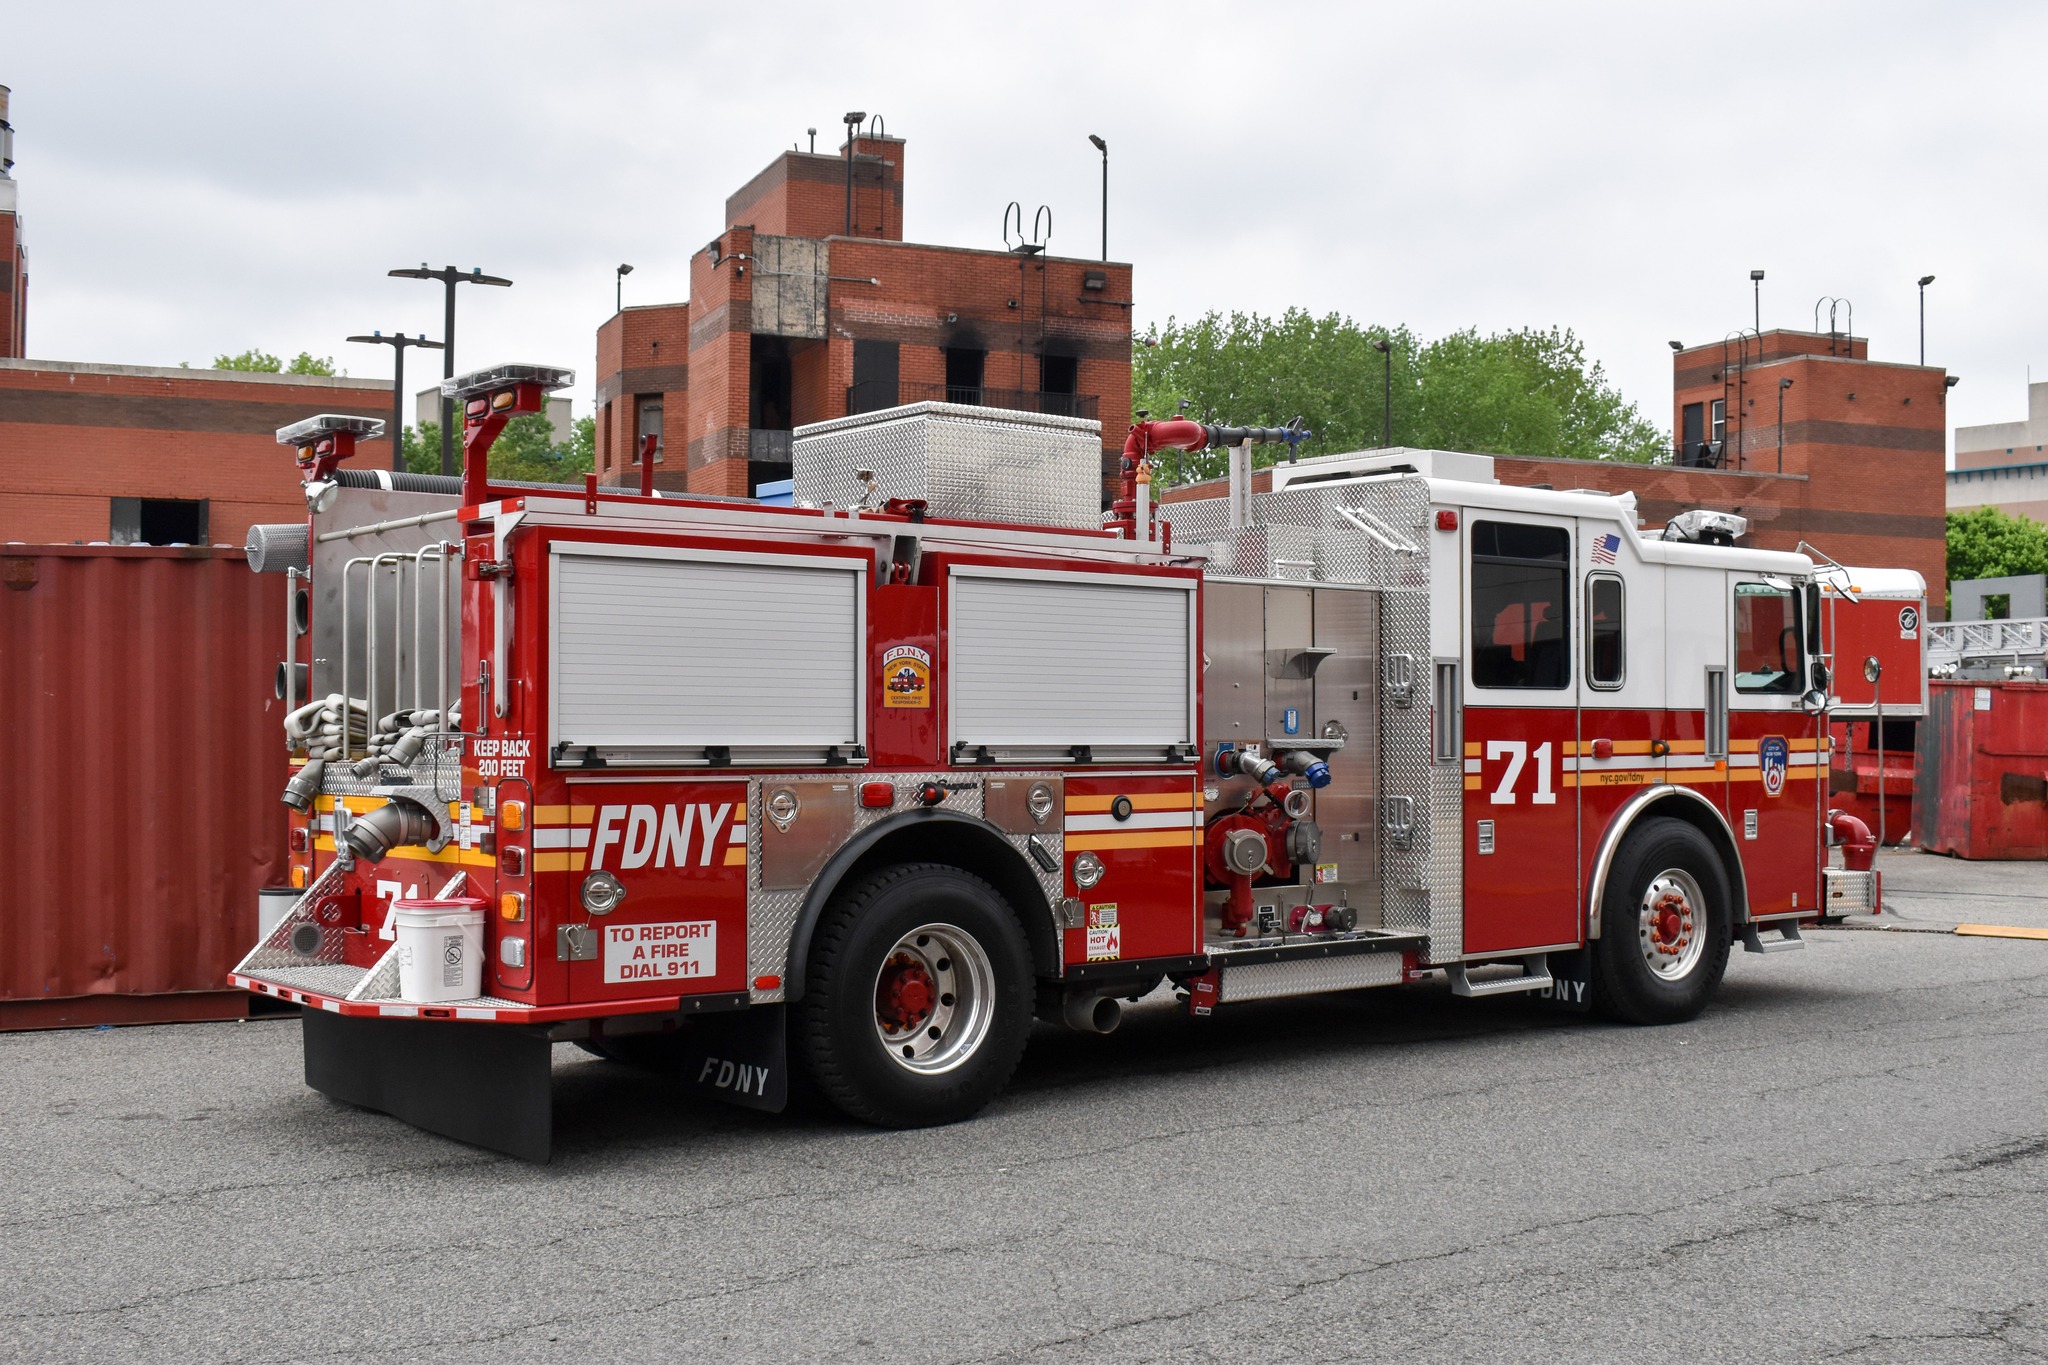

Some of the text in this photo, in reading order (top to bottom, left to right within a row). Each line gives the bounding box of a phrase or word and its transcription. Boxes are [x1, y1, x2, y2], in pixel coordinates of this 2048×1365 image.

[886, 648, 927, 661] F.D.N.Y.
[887, 663, 898, 672] NEW
[913, 662, 926, 673] STATE
[474, 740, 531, 757] KEEP BACK
[479, 759, 525, 777] 200 FEET
[1486, 740, 1557, 805] 71
[1600, 772, 1645, 784] nyc.gov/fdny
[590, 803, 732, 871] FDNY
[377, 880, 418, 941] 7
[610, 923, 712, 942] TO REPORT
[1090, 936, 1106, 944] HOT
[632, 943, 689, 960] A FIRE
[620, 961, 699, 979] DIAL 911
[698, 1057, 769, 1096] FDNY
